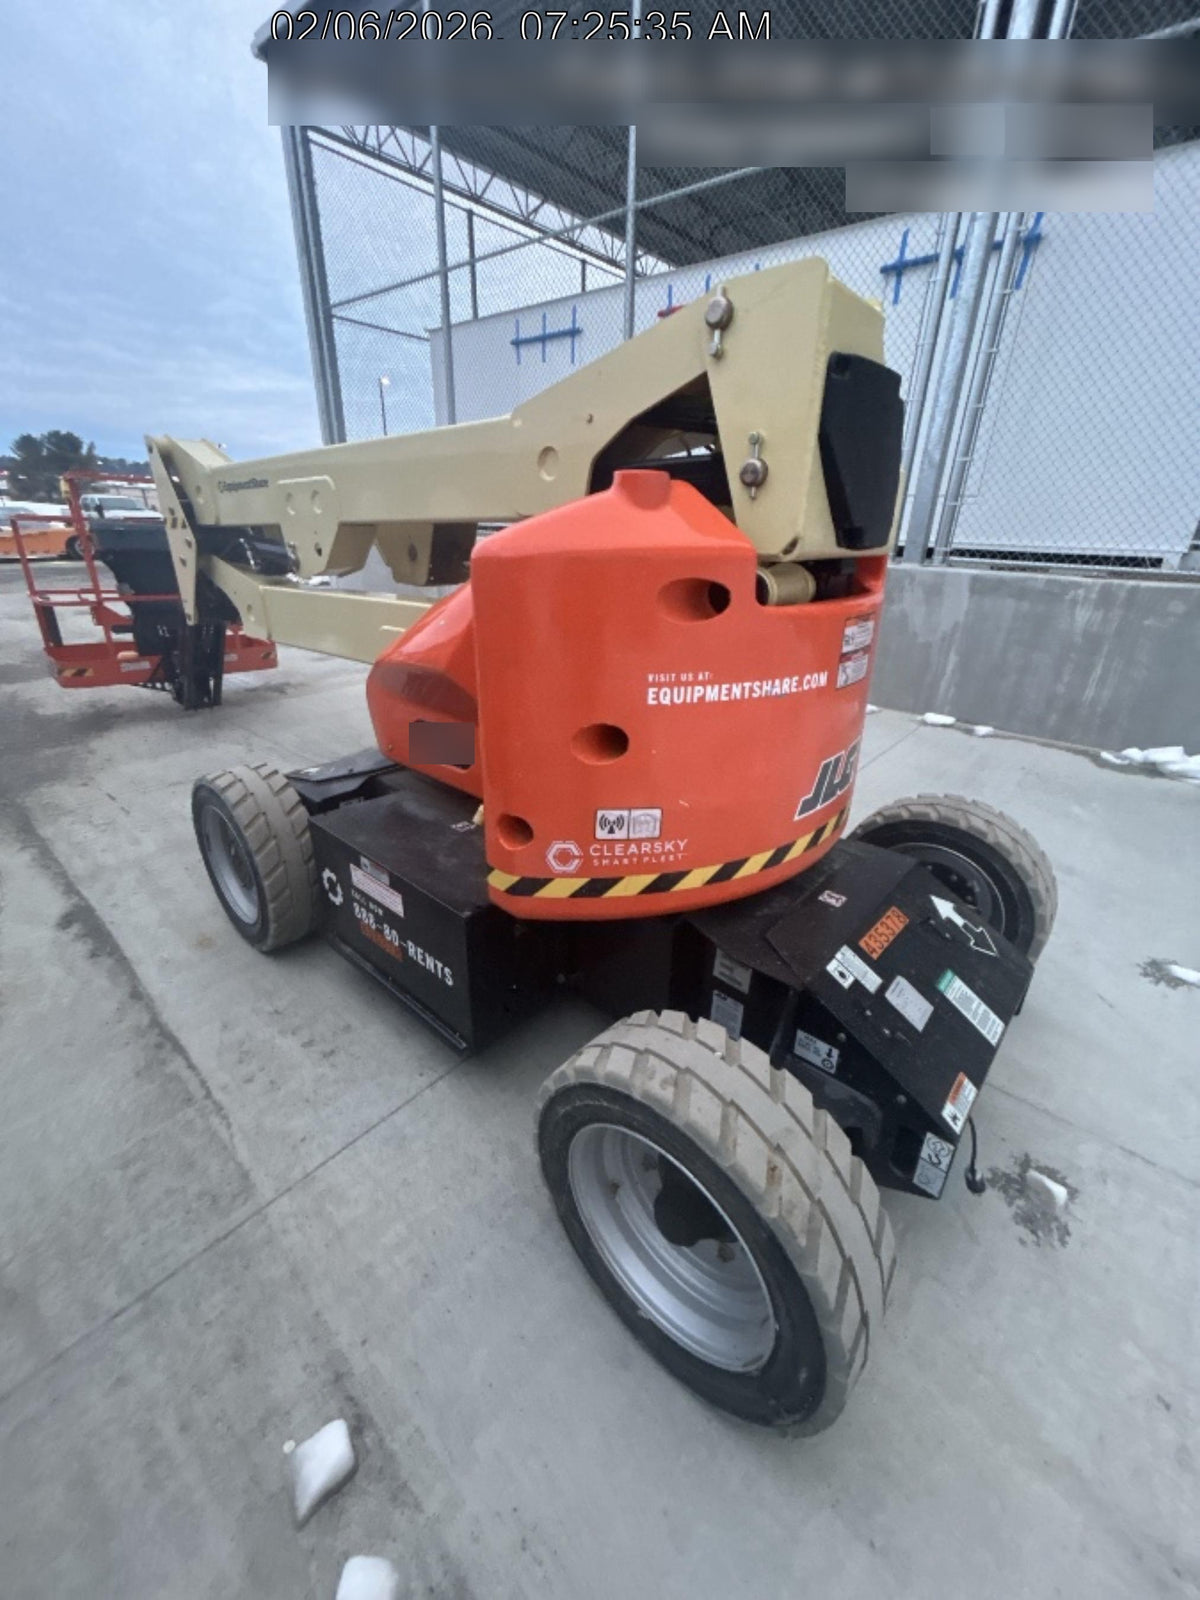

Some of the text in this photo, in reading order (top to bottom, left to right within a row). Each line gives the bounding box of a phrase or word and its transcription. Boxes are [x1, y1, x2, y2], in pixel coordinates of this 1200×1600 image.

[647, 673, 676, 683] VISIT
[681, 672, 694, 682] US
[647, 670, 828, 706] EQUIPMENTSHARE.COM
[589, 839, 688, 857] CLEARSKY
[593, 857, 638, 866] SMART
